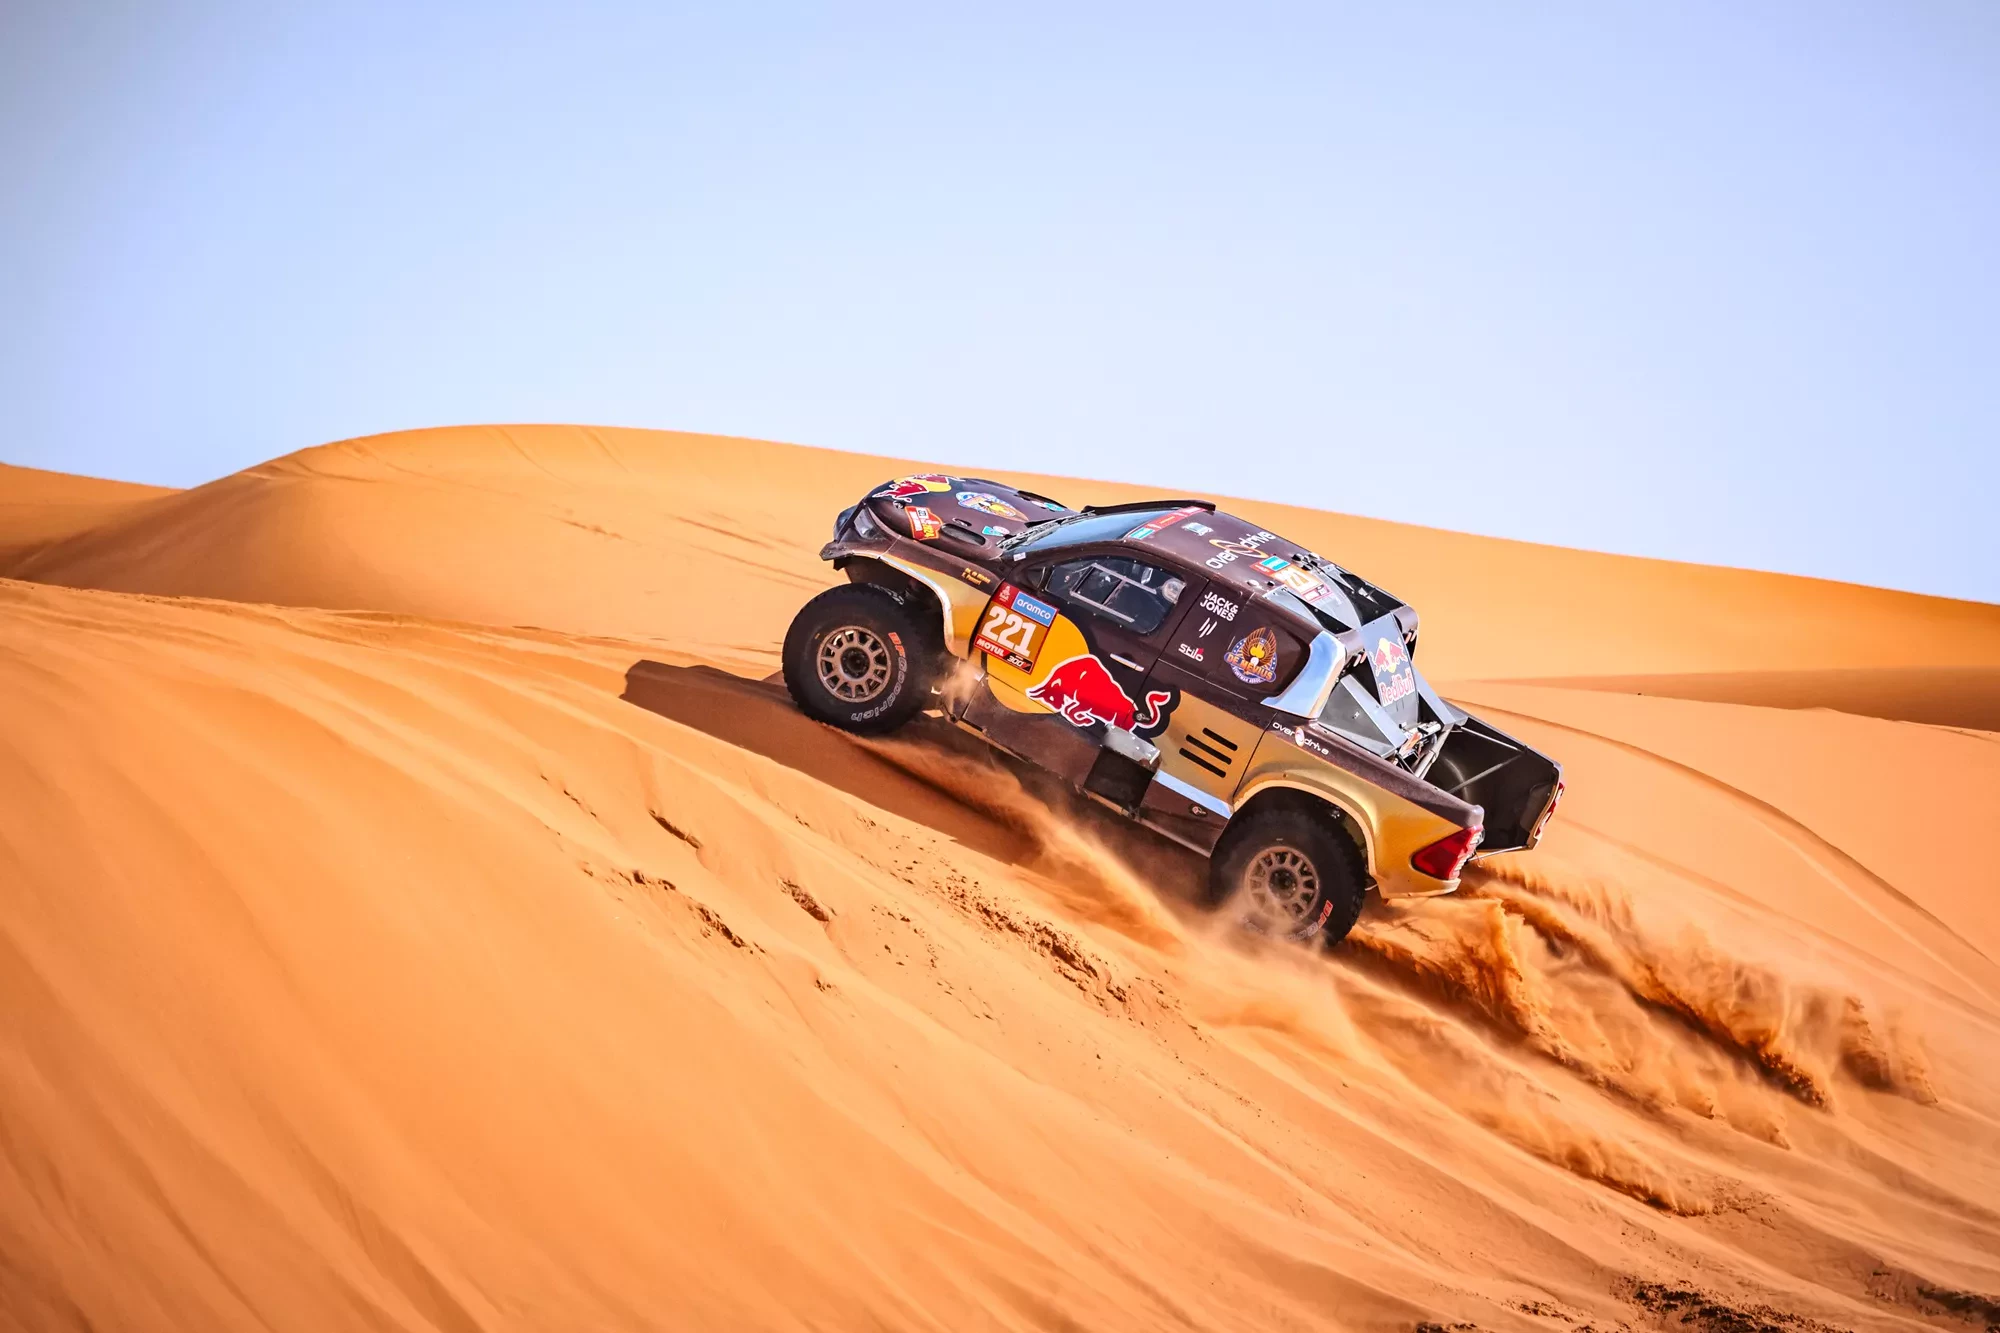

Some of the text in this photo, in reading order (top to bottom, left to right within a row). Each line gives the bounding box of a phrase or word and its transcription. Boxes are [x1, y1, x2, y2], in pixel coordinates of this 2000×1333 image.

[1016, 598, 1051, 620] aramco
[1200, 599, 1235, 621] JONES
[981, 605, 1037, 657] 221
[976, 638, 1005, 657] MOTUL
[1227, 653, 1273, 680] DE MEVIUS
[1272, 722, 1295, 736] over
